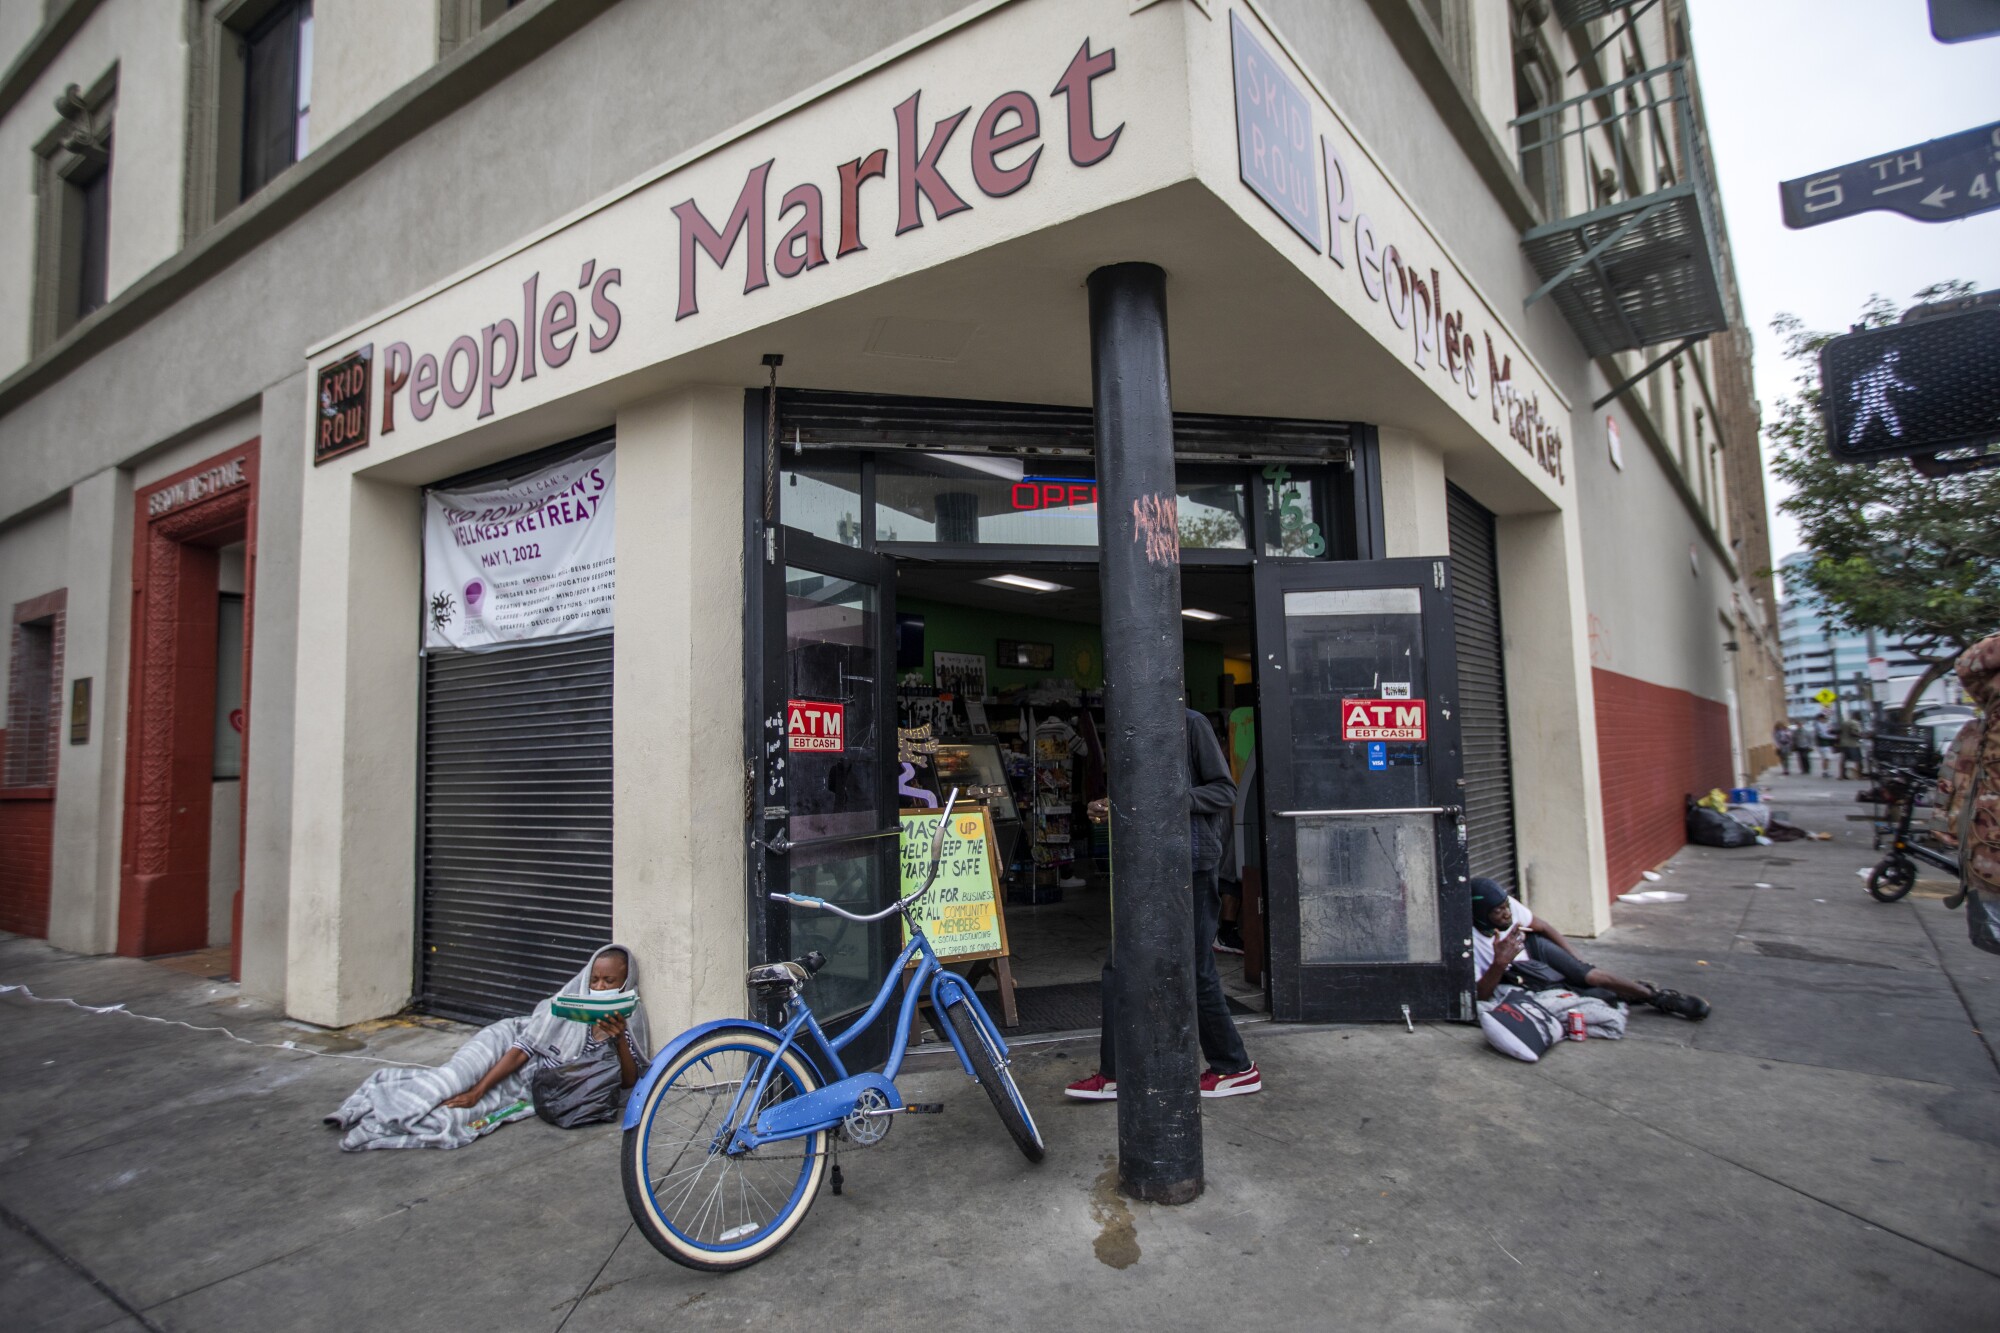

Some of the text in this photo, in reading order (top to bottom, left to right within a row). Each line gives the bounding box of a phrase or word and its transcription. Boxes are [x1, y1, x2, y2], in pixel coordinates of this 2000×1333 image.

[1246, 54, 1306, 153] SKID
[1252, 122, 1310, 220] ROW
[381, 36, 1126, 435] People's Market
[1321, 134, 1566, 486] People's Market
[321, 363, 364, 408] SKID
[321, 405, 362, 449] ROW
[1011, 483, 1098, 512] OPE
[515, 495, 600, 534] RETREAT
[481, 552, 501, 569] MAY
[514, 543, 542, 562] 2022
[562, 613, 579, 621] FOOD
[591, 607, 611, 616] MORE!
[788, 708, 841, 735] ATM
[1346, 705, 1422, 727] ATM
[793, 738, 836, 748] EBT CASH
[1355, 729, 1414, 738] EBT CASH
[900, 819, 977, 839] MASK UP
[900, 839, 984, 859] HELP EEP THE
[952, 858, 980, 877] SAFE
[939, 888, 959, 903] FOR
[961, 890, 995, 902] BUSINESS
[905, 903, 990, 921] OR ALL COMMUNITY
[938, 917, 981, 934] MEMBERS
[938, 934, 959, 943] SOCIAL
[969, 944, 977, 952] OF
